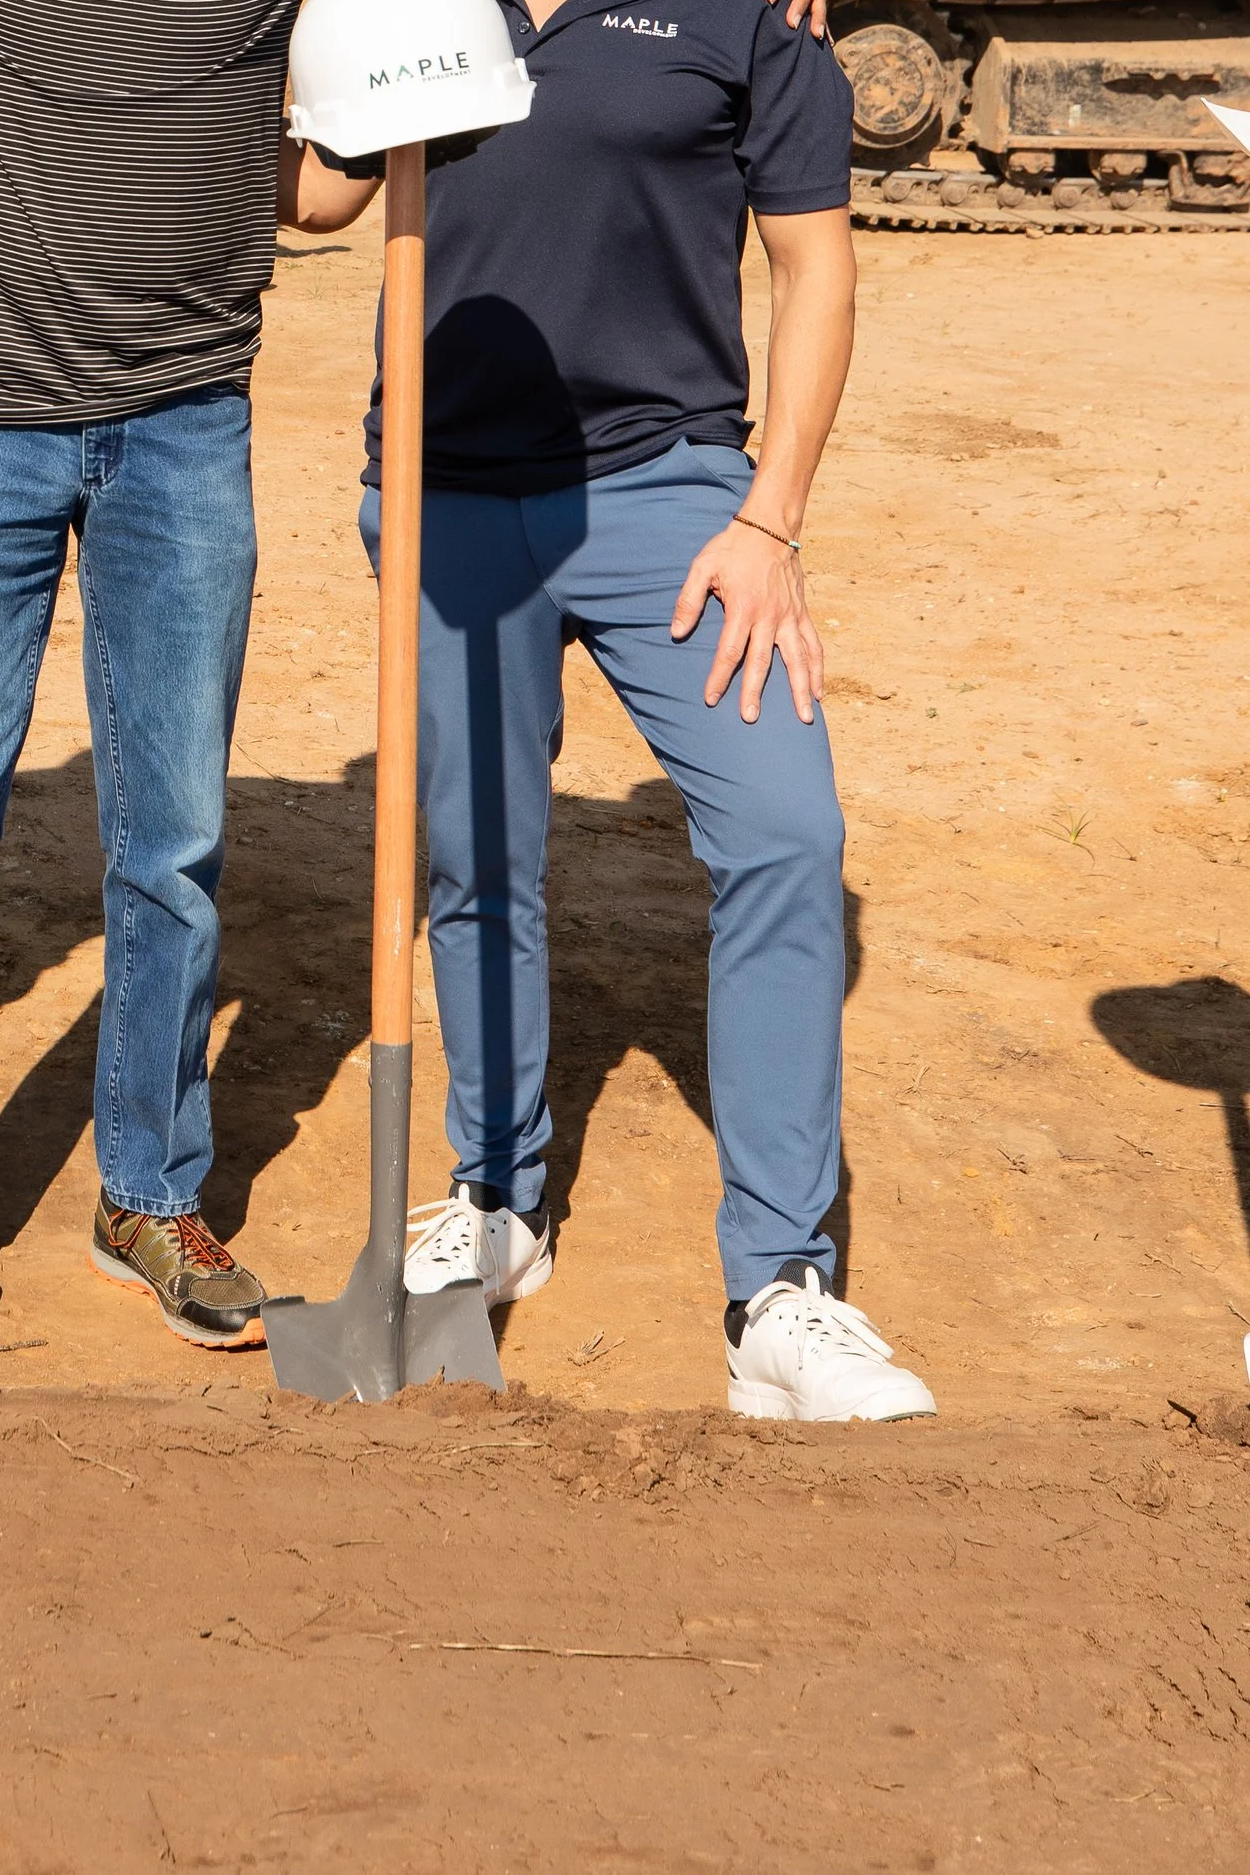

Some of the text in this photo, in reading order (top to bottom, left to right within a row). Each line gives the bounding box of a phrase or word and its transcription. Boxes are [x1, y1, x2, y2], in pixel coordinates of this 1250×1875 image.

[602, 13, 678, 34] MAPLE
[369, 51, 469, 89] MAPLE
[422, 69, 471, 82] DEVELOPMENT
